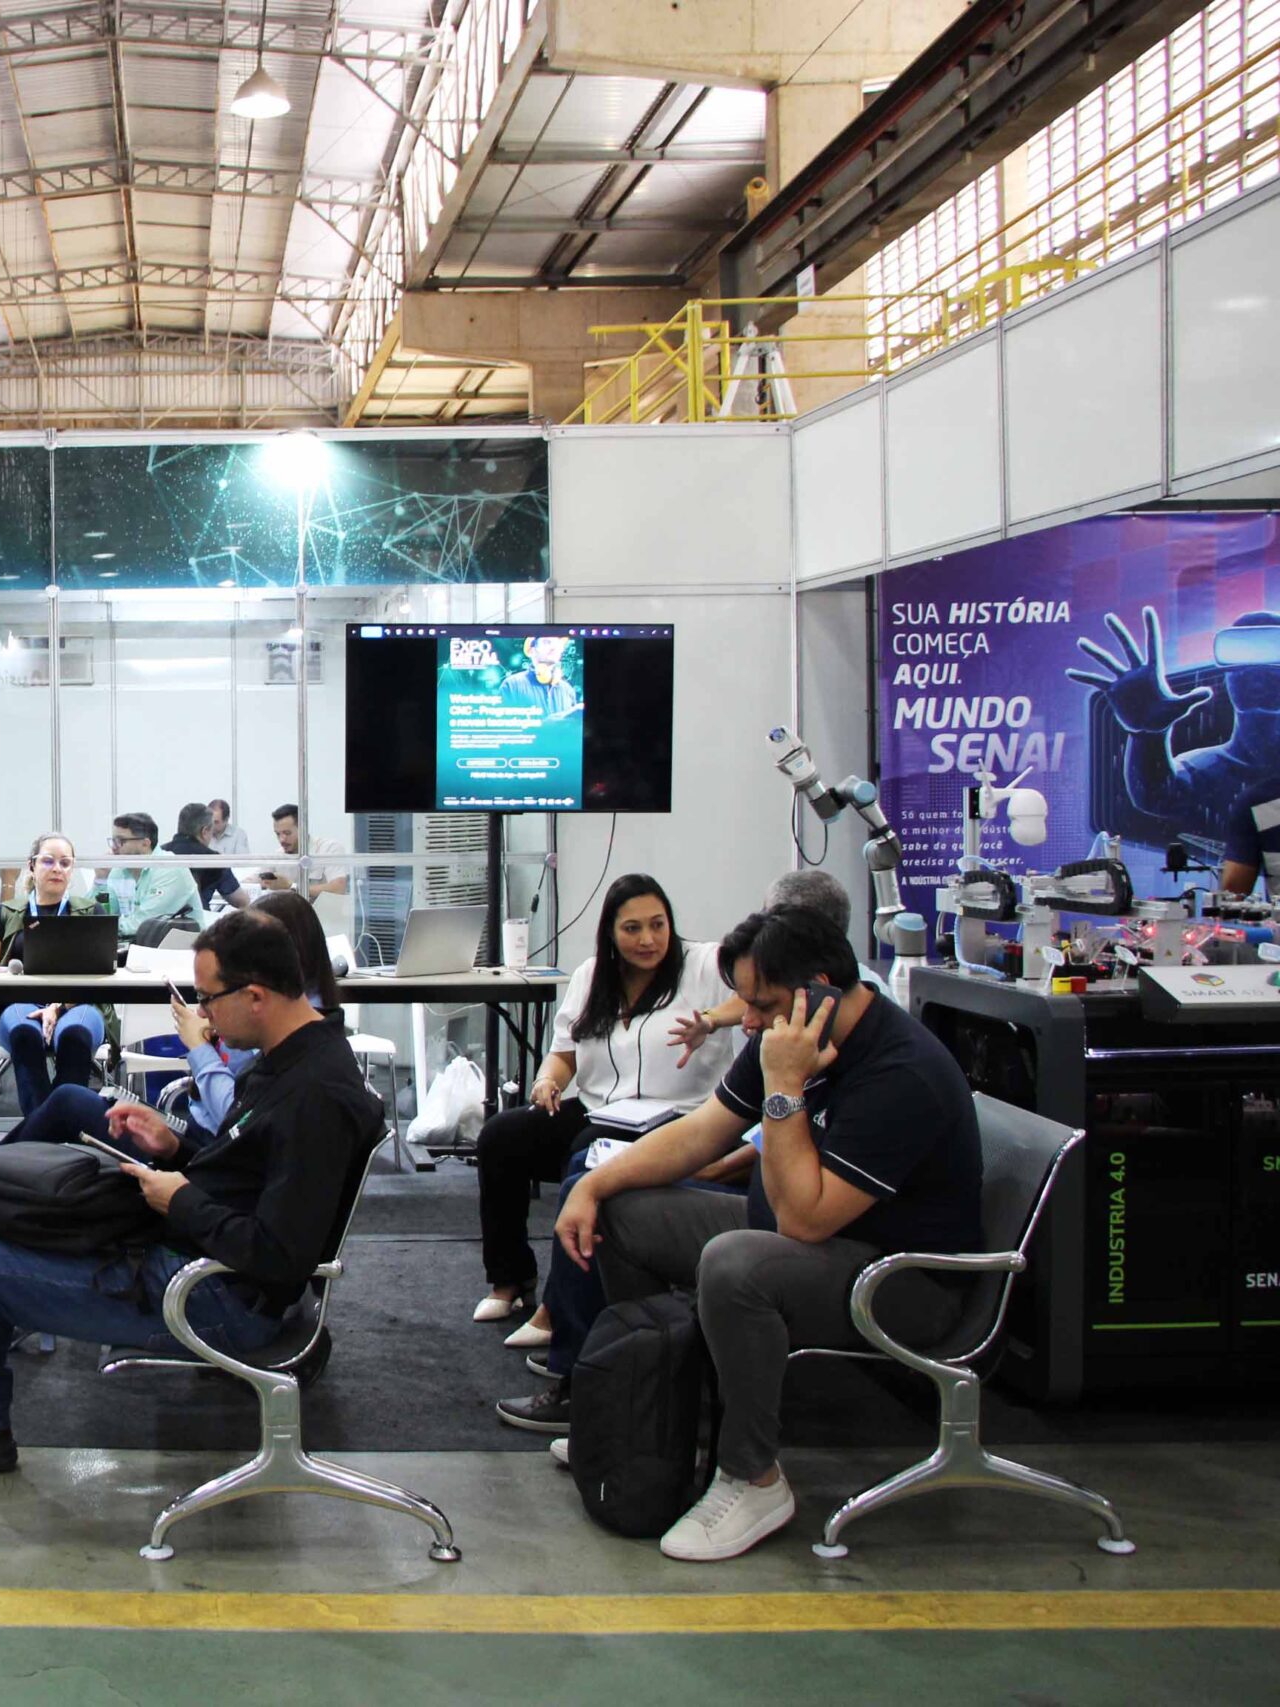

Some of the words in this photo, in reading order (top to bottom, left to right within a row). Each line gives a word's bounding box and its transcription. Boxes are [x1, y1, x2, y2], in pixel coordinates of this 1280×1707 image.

[892, 602, 941, 626] SUA
[947, 596, 1071, 625] HISTÓRIA
[892, 632, 991, 659] COMEÇA
[893, 662, 962, 690] AQUI.
[893, 695, 1032, 730] MUNDO
[928, 731, 1067, 774] SENAI
[1109, 1152, 1126, 1183] 4.0
[1108, 1187, 1126, 1304] INDUSTRIA
